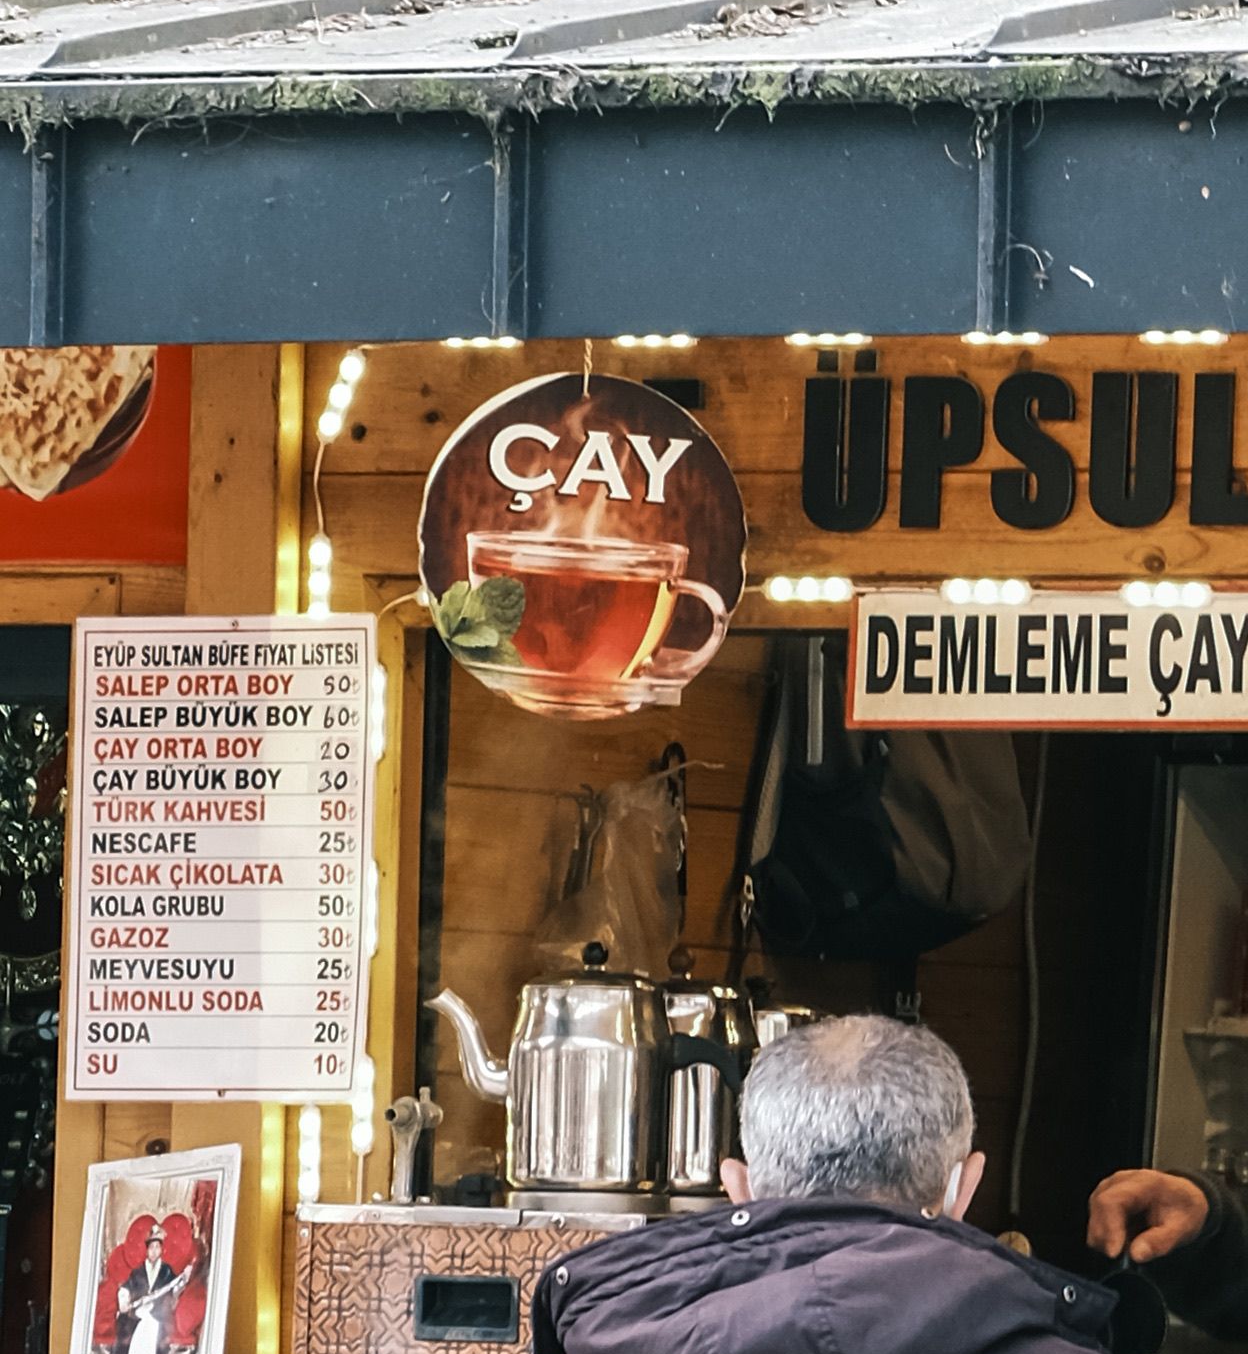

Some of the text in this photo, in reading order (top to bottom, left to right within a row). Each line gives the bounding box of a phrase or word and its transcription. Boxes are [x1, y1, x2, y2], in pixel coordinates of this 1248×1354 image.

[488, 422, 693, 512] ÇAY
[94, 641, 136, 667] EYÜP
[141, 644, 201, 667] SULTAN
[208, 640, 249, 667] BÜFE
[866, 613, 1131, 696] DEMLEME
[96, 674, 169, 696] SALEP
[177, 674, 239, 696] ORTA
[247, 673, 294, 696] BOY
[94, 706, 168, 728] SALEP
[175, 700, 258, 728] BÜYÜK
[266, 705, 313, 727] BOY
[94, 737, 140, 764] ÇAY
[146, 737, 208, 759] ORTA
[215, 737, 263, 759] BOY
[93, 769, 138, 796] ÇAY
[145, 764, 226, 791] BÜYÜK
[234, 767, 282, 790] BOY
[92, 797, 155, 822] TÜRK
[164, 794, 266, 822] KAHVESİ
[92, 832, 197, 854] NESCAFE
[91, 864, 161, 886] SICAK
[169, 858, 284, 890] ÇİKOLATA
[90, 895, 146, 917] KOLA
[152, 895, 225, 917] GRUBU
[90, 927, 170, 949] GAZOZ
[89, 958, 235, 980] MEYVESUYU
[88, 985, 194, 1012] LİMONLU
[201, 990, 264, 1012] SODA
[87, 1022, 151, 1044] SODA
[86, 1053, 119, 1075] SU
